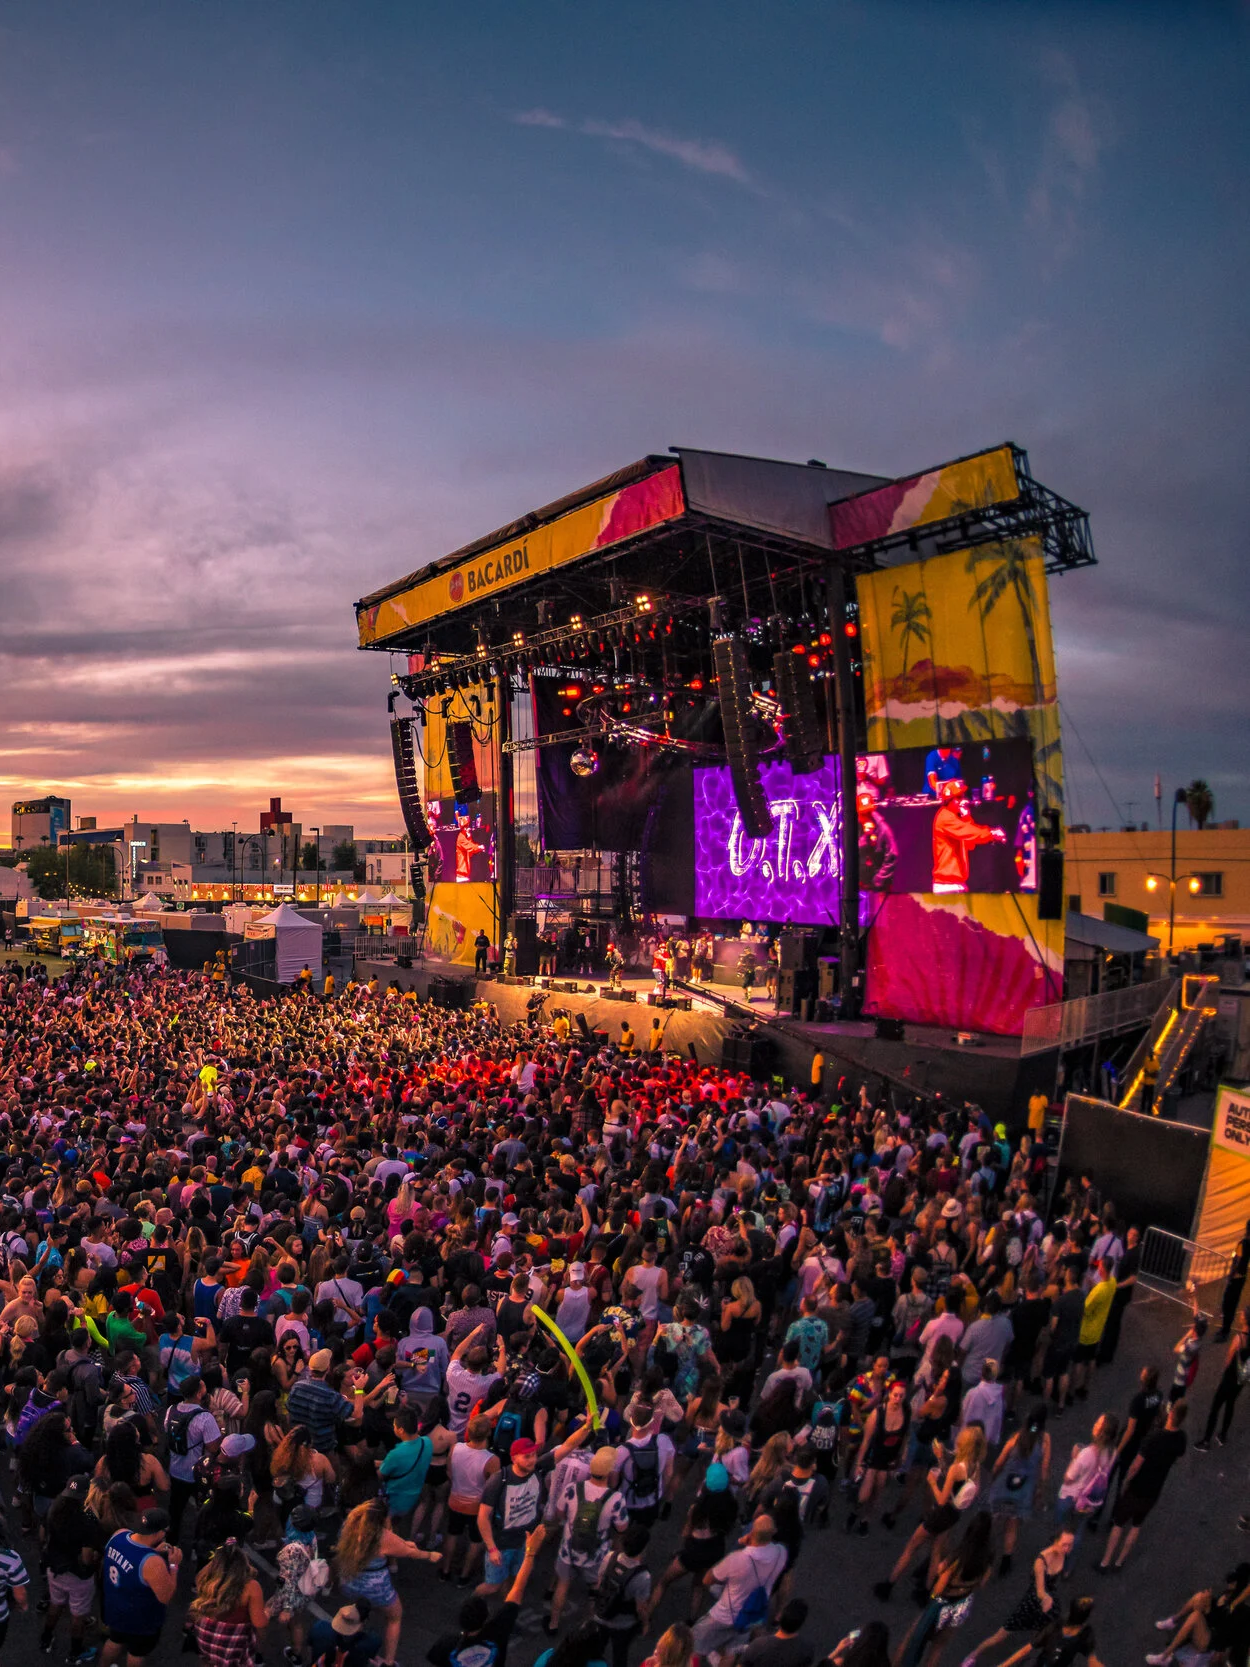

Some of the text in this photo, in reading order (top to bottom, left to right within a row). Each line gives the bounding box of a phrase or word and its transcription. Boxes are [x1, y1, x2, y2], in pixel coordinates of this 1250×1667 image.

[467, 538, 530, 593] BACARDÍ
[454, 1391, 471, 1414] 2
[107, 1546, 134, 1573] BRYANT
[109, 1565, 120, 1587] 8
